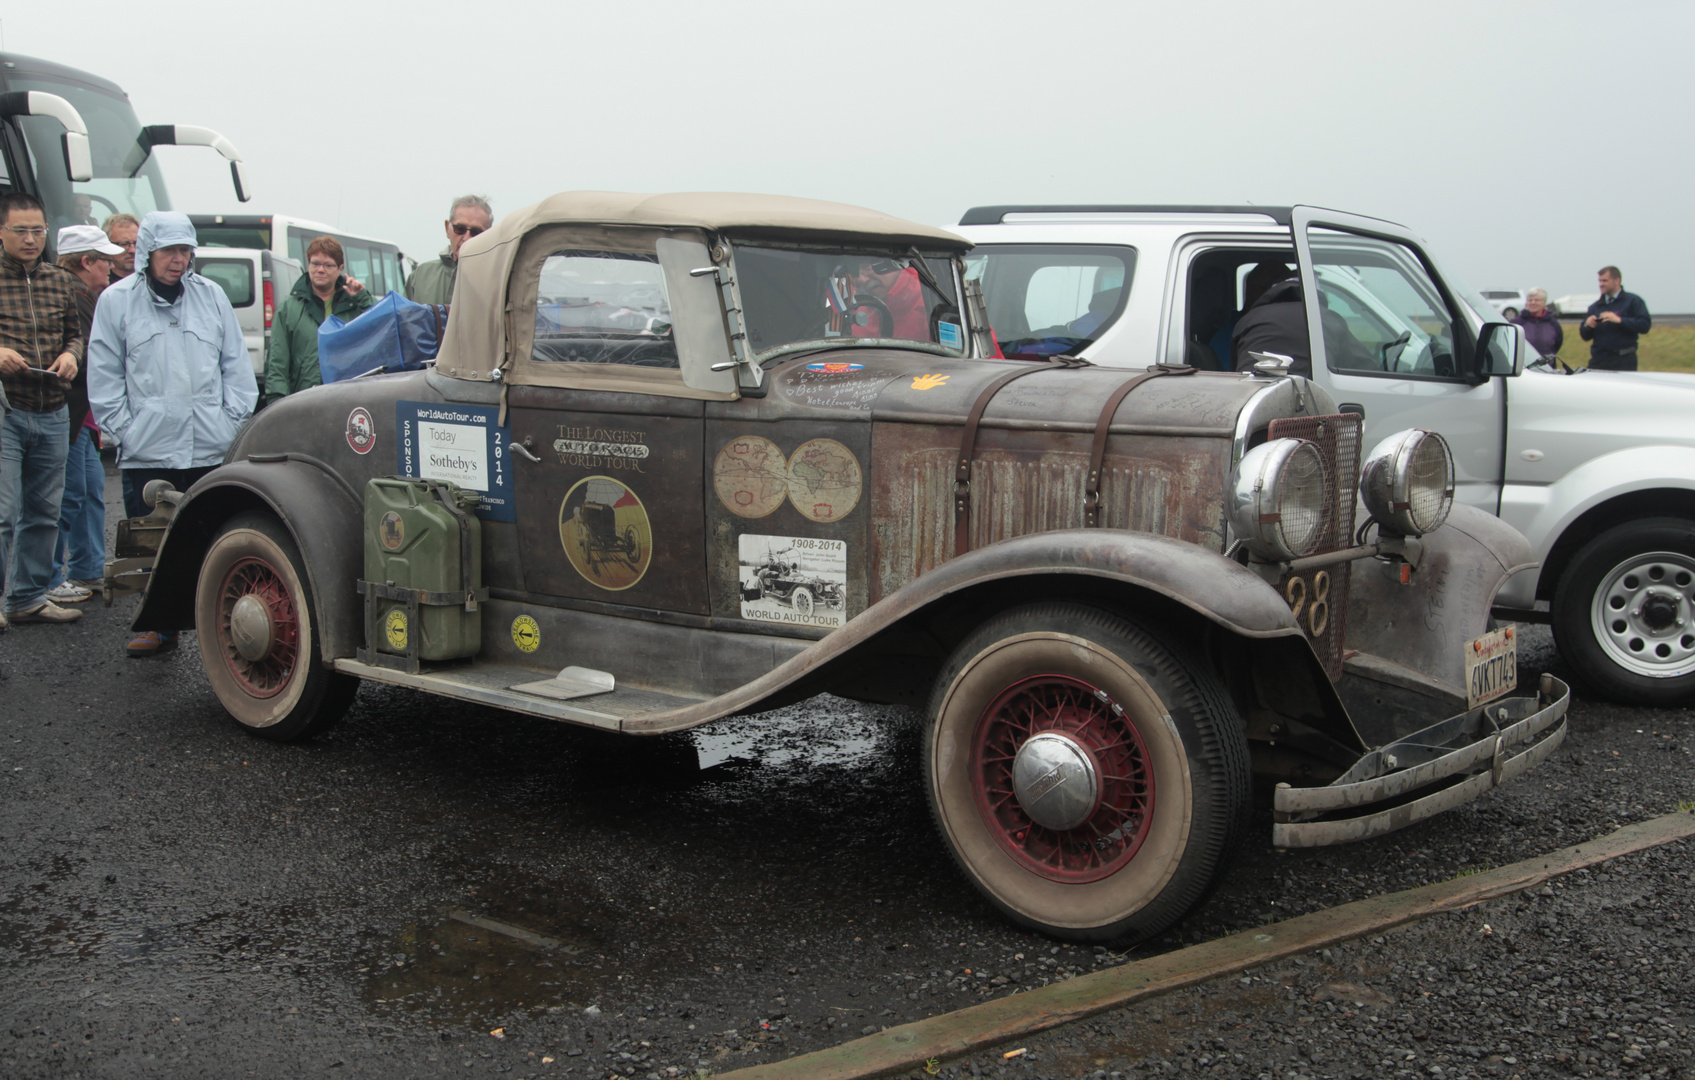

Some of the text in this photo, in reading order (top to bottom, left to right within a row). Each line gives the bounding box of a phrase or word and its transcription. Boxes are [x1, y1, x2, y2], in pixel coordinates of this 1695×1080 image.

[796, 384, 824, 396] Best
[417, 408, 486, 423] WorldAutoTour.com
[429, 427, 456, 444] Today
[556, 424, 646, 444] THE LONGEST
[430, 454, 478, 473] Sotheby's
[494, 432, 504, 487] 2014
[557, 453, 647, 474] WORLD TOUR
[791, 538, 842, 551] 1908-2014
[746, 609, 839, 626] WORLD AUTO TOUR
[513, 618, 539, 638] YELLOWSTONE
[1472, 650, 1514, 698] 6VKT743
